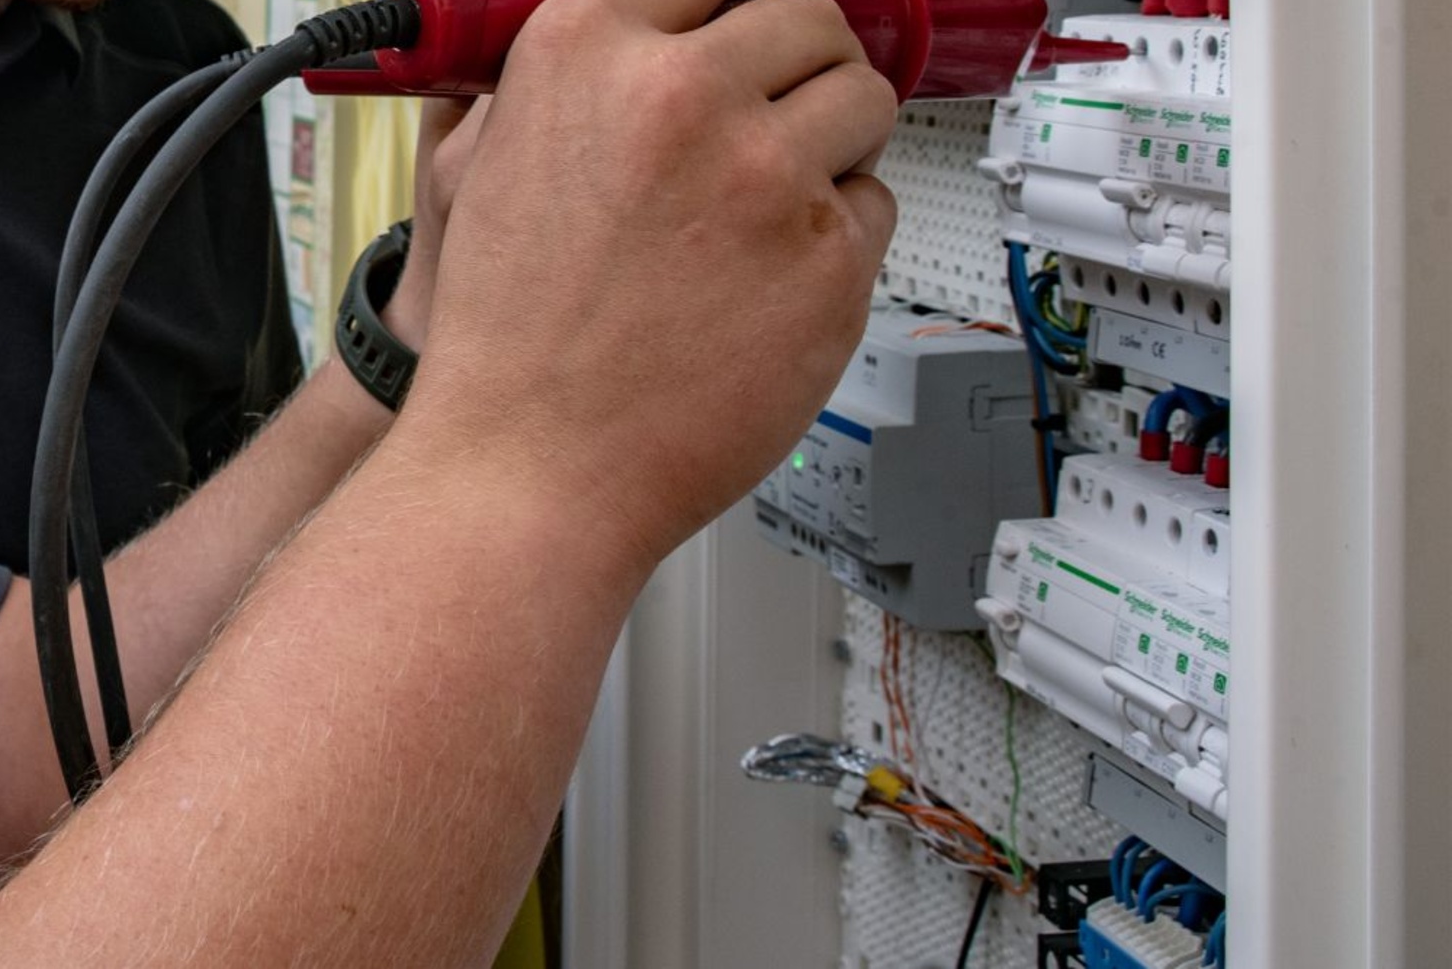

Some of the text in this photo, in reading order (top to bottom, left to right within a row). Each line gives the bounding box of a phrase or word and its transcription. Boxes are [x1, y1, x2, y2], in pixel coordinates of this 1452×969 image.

[1125, 104, 1157, 117] Schneider
[1160, 108, 1195, 122] Schneider
[1151, 340, 1166, 359] CE
[1125, 590, 1158, 615] Schneider
[1160, 608, 1196, 634] Schneider
